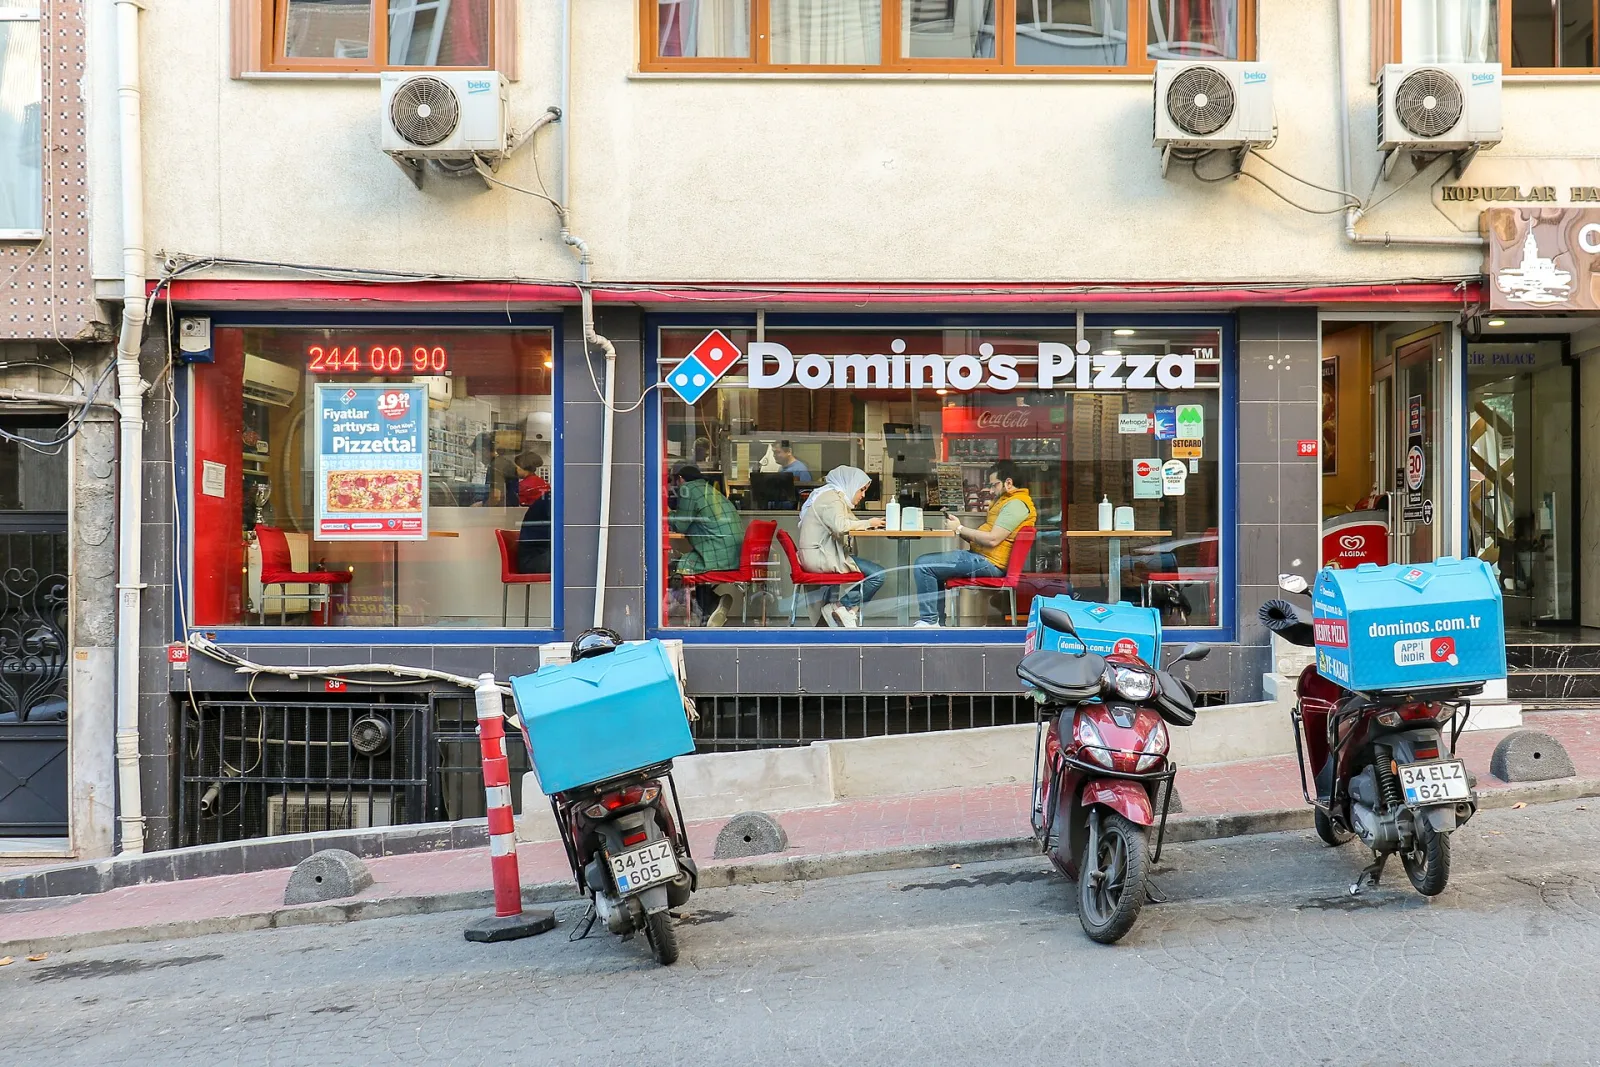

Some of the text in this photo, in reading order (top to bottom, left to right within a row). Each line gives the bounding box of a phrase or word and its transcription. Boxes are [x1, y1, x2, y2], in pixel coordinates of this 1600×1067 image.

[1244, 71, 1267, 80] beko
[1471, 73, 1495, 81] beko
[467, 80, 491, 89] beko
[1442, 186, 1557, 201] KOPUZLAR
[309, 346, 446, 371] 244 00 90
[747, 338, 1019, 390] Domino's
[1038, 339, 1195, 390] Pizza
[1492, 353, 1536, 365] PALACE
[377, 393, 399, 410] 19
[323, 408, 369, 422] Fiyatlar
[1120, 419, 1147, 427] Metropol
[333, 436, 417, 453] Pizzetta!
[1172, 439, 1202, 448] SETCARD
[1409, 454, 1421, 474] 30
[1368, 614, 1482, 638] dominos.com.tr
[1400, 651, 1425, 663] İNDİR
[1404, 764, 1463, 784] 34 ELZ
[1419, 783, 1450, 799] 621
[614, 843, 671, 873] 34 ELZ
[630, 864, 662, 885] 605
